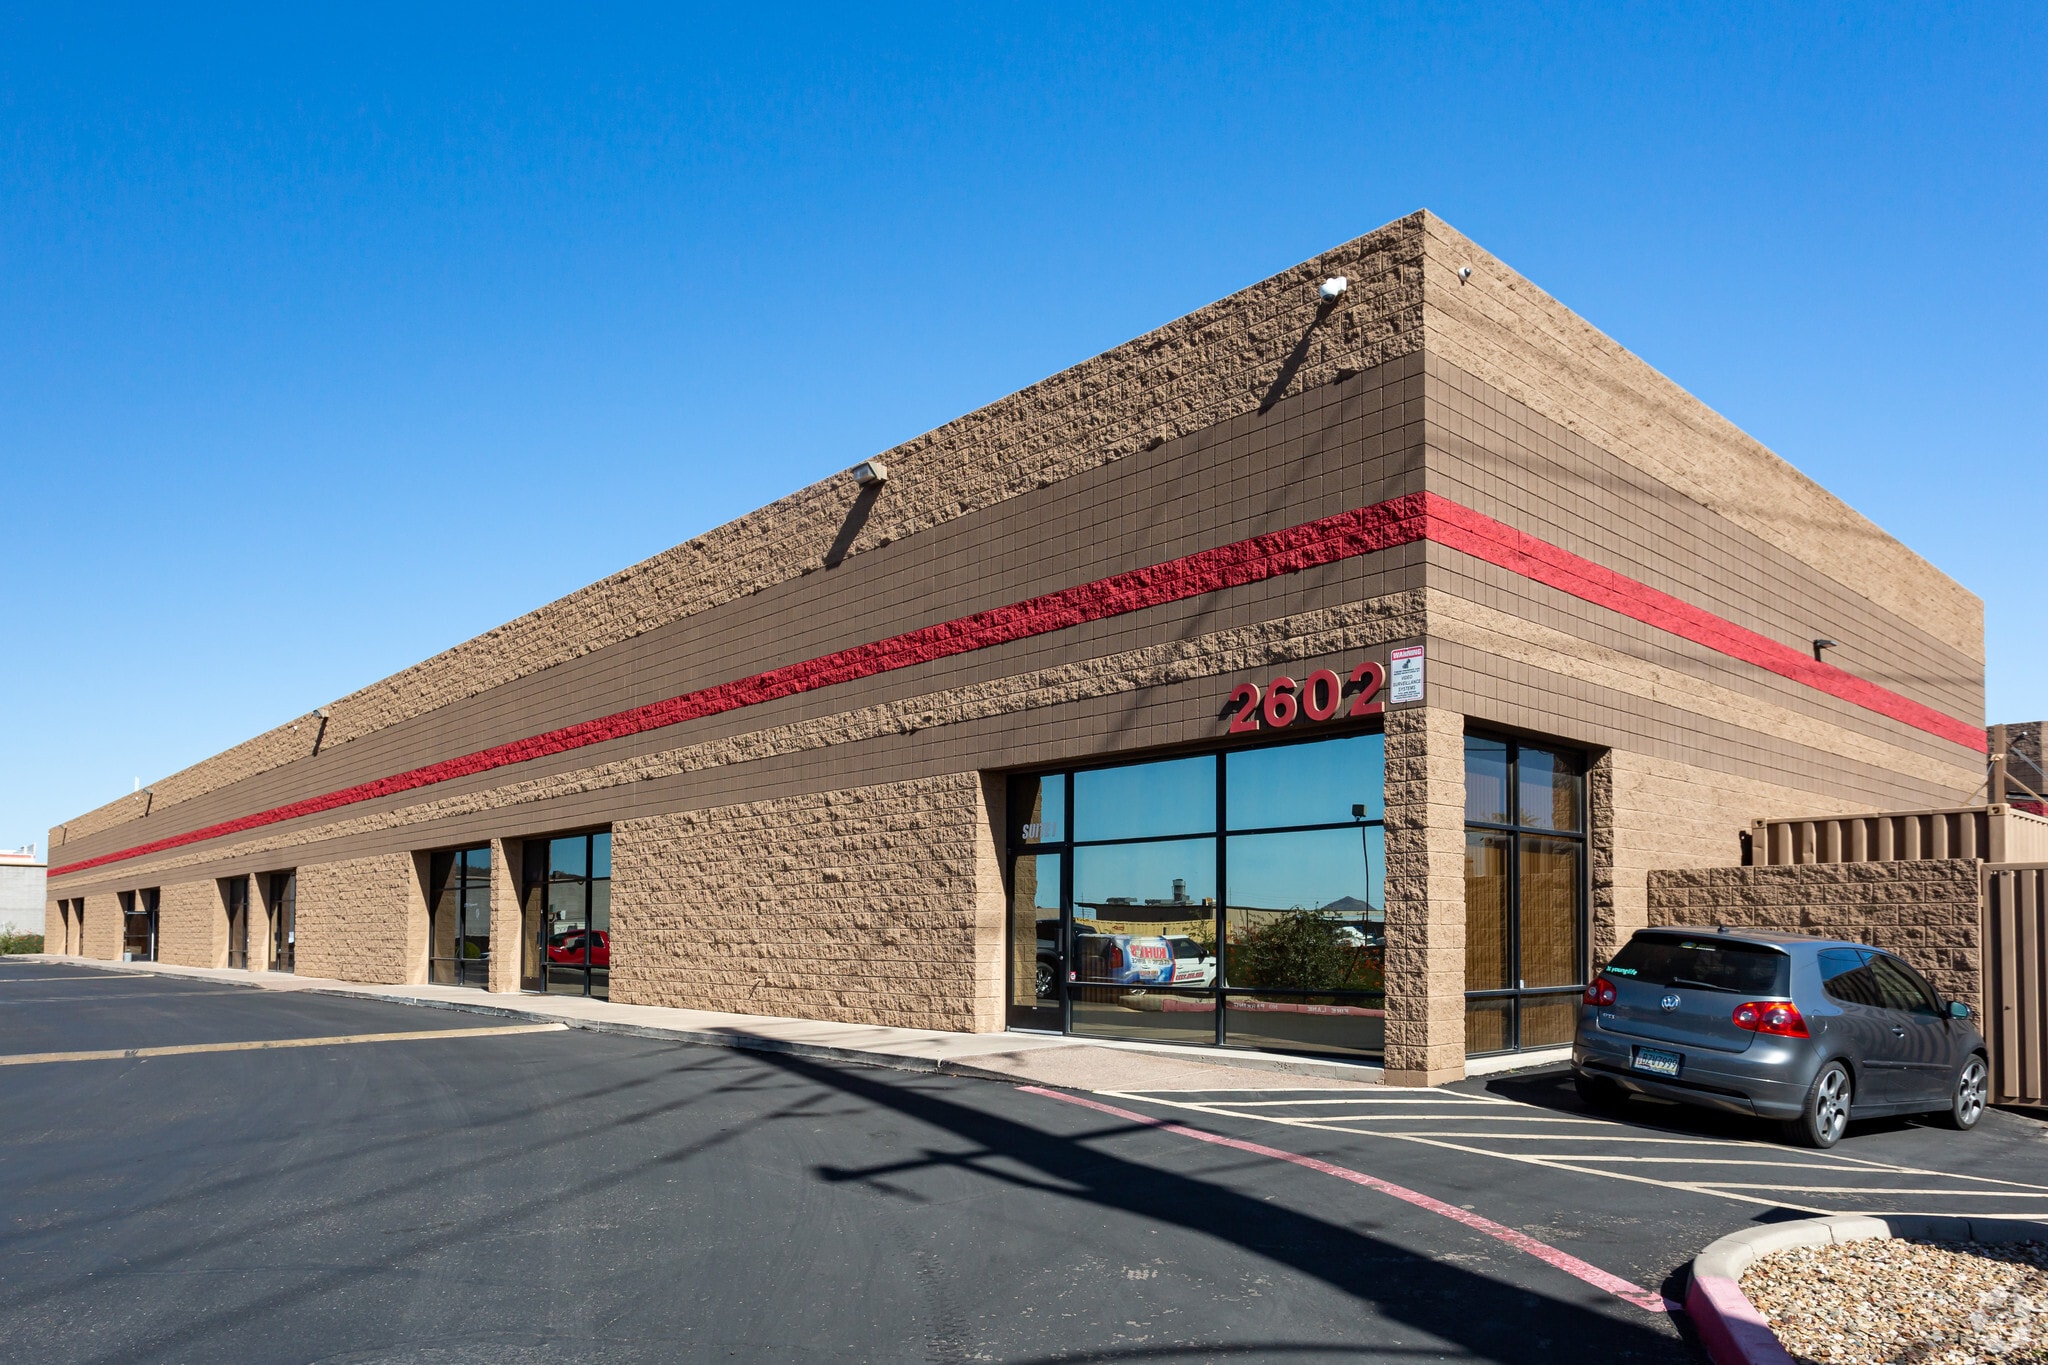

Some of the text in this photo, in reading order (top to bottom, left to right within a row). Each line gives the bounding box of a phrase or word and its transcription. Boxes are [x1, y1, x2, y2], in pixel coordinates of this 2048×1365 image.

[1393, 679, 1421, 687] SURVEILLANCE
[1229, 661, 1386, 734] 2602
[1022, 821, 1051, 839] SUITE
